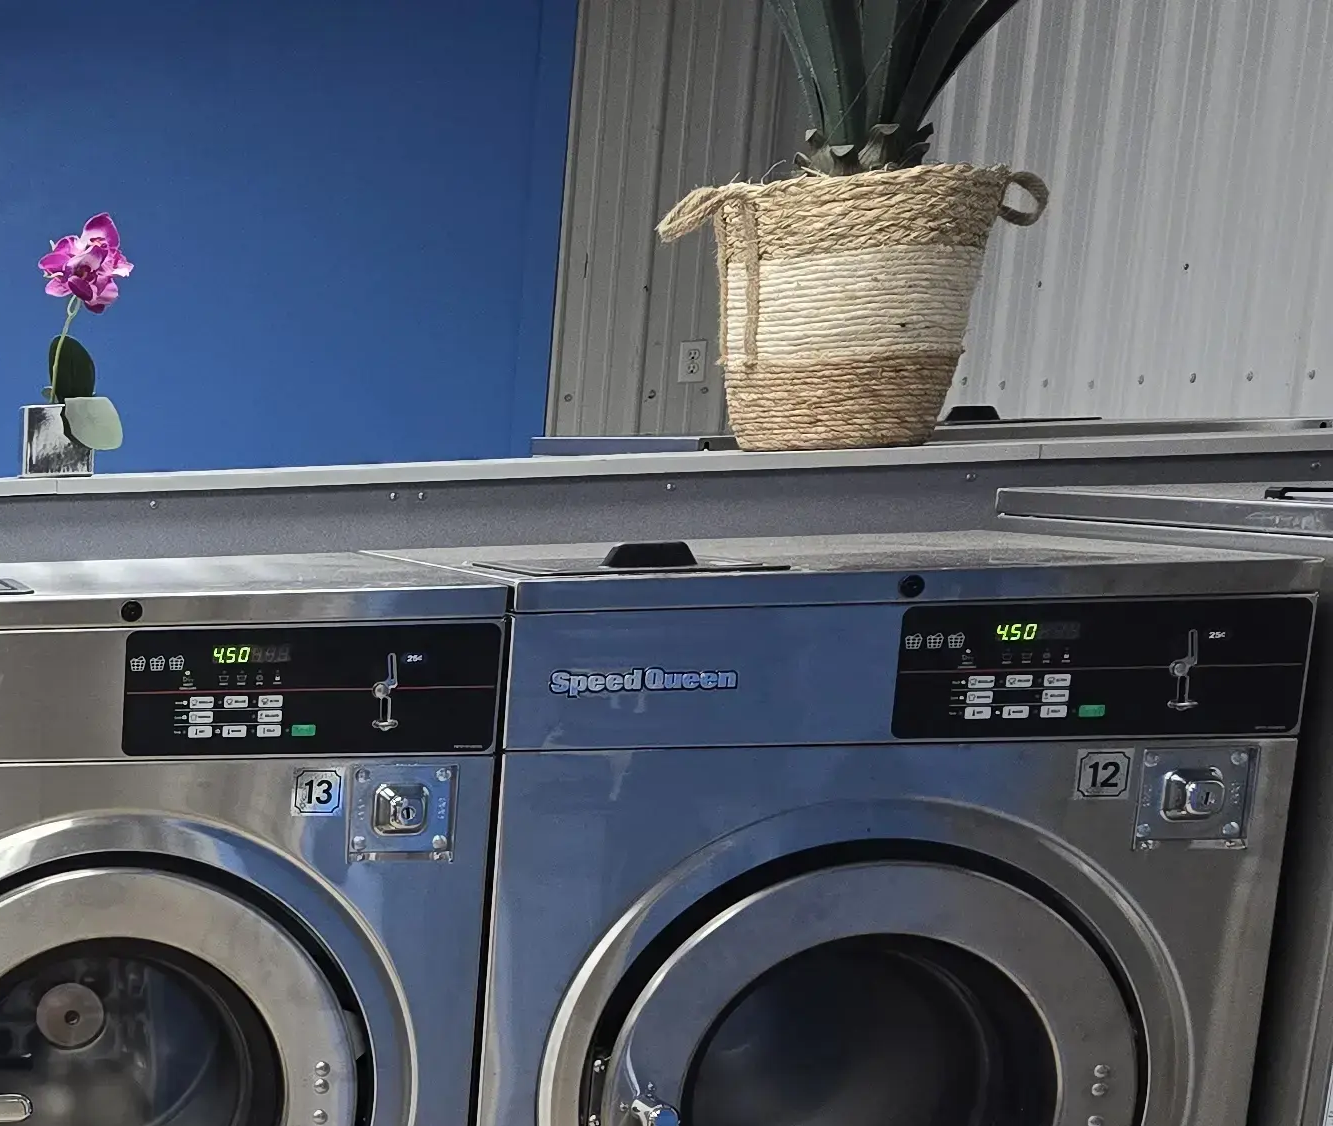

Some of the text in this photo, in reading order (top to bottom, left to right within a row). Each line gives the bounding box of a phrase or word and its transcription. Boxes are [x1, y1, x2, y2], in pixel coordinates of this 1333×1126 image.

[549, 666, 738, 698] Speed Queen
[1087, 761, 1121, 789] 12
[303, 780, 333, 805] 13
